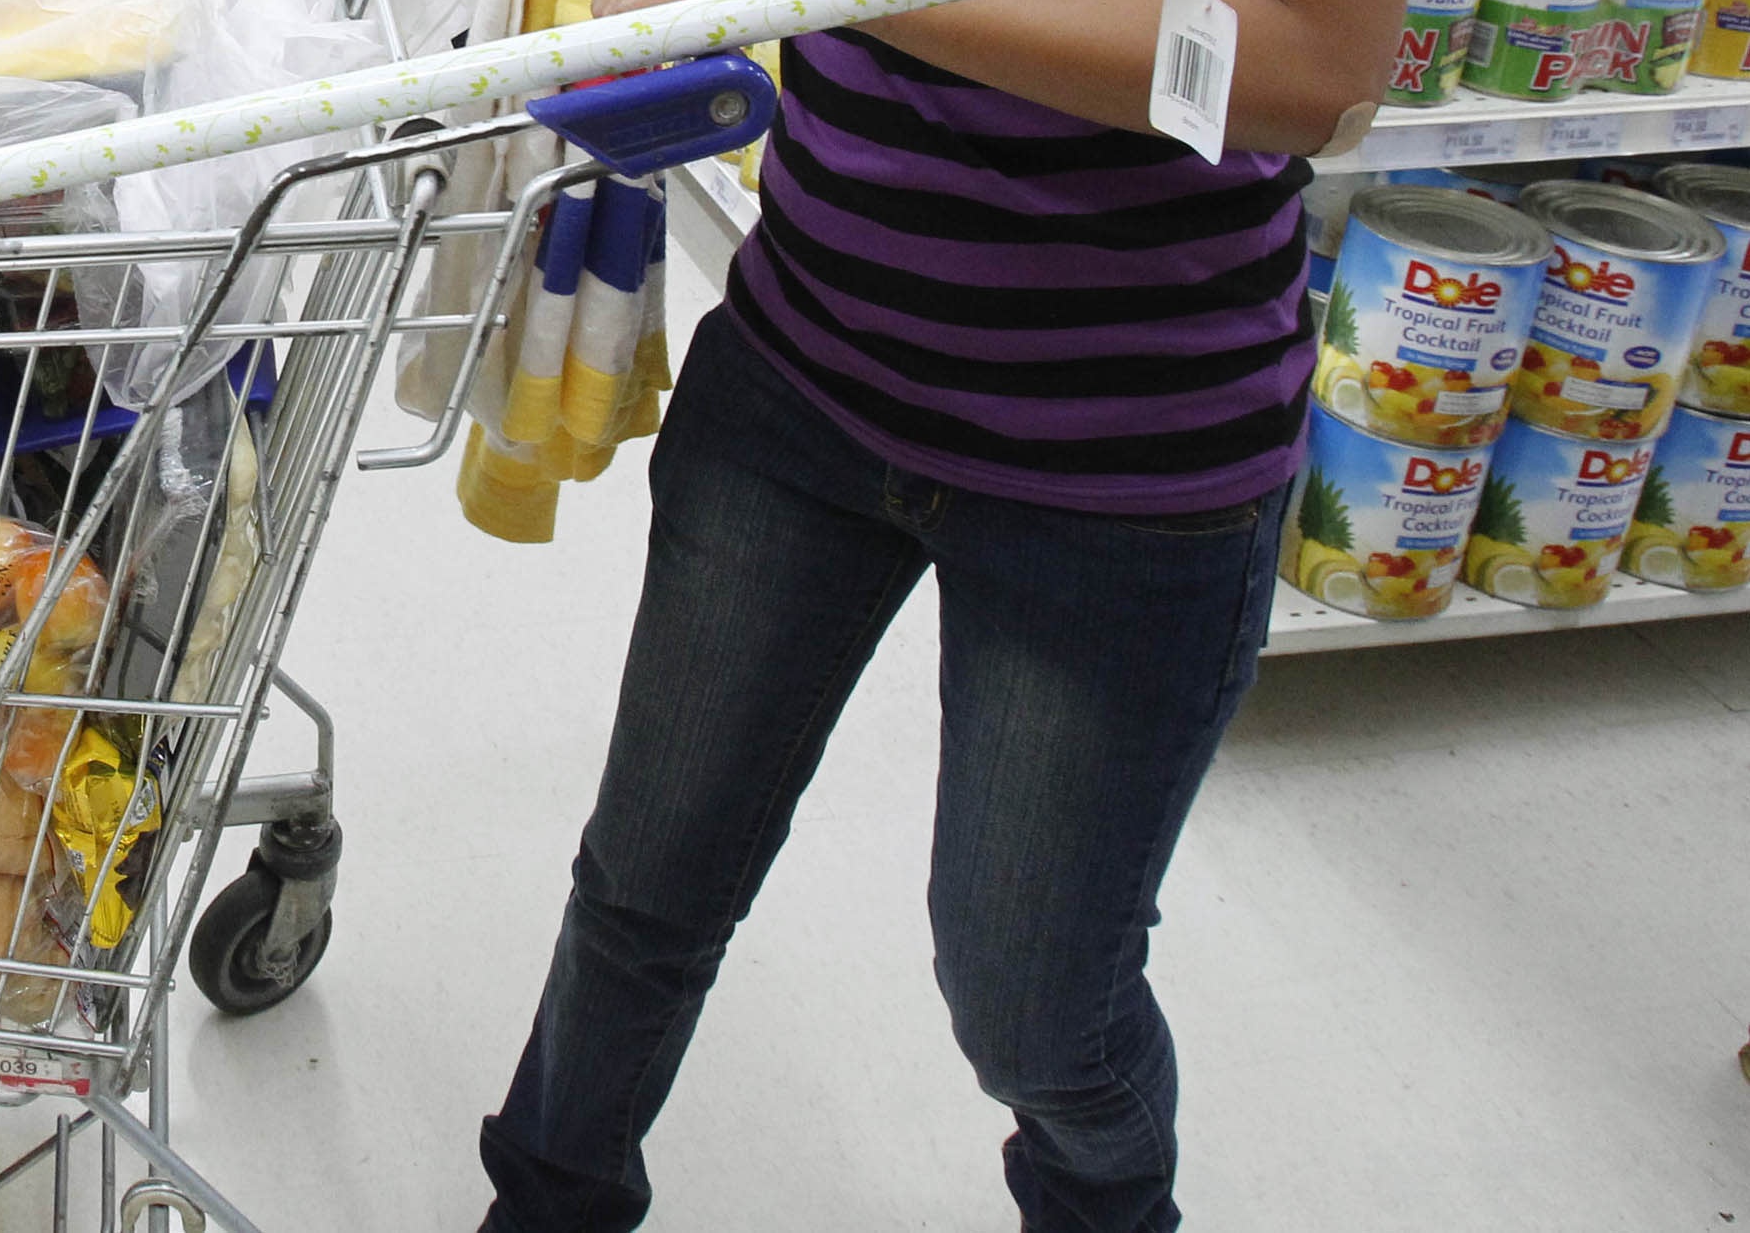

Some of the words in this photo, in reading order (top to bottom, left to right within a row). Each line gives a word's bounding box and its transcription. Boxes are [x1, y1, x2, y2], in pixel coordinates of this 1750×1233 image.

[1403, 259, 1501, 308] Dole
[1383, 298, 1461, 332] Tropical
[1466, 318, 1507, 336] Fruit
[1535, 306, 1612, 343] Cocktail
[1595, 307, 1643, 329] Fruit
[1402, 326, 1481, 352] Cocktail
[1403, 456, 1483, 494] Dole
[1578, 448, 1650, 484] Dole
[1382, 494, 1453, 515] Tropical
[0, 1059, 38, 1075] 039
